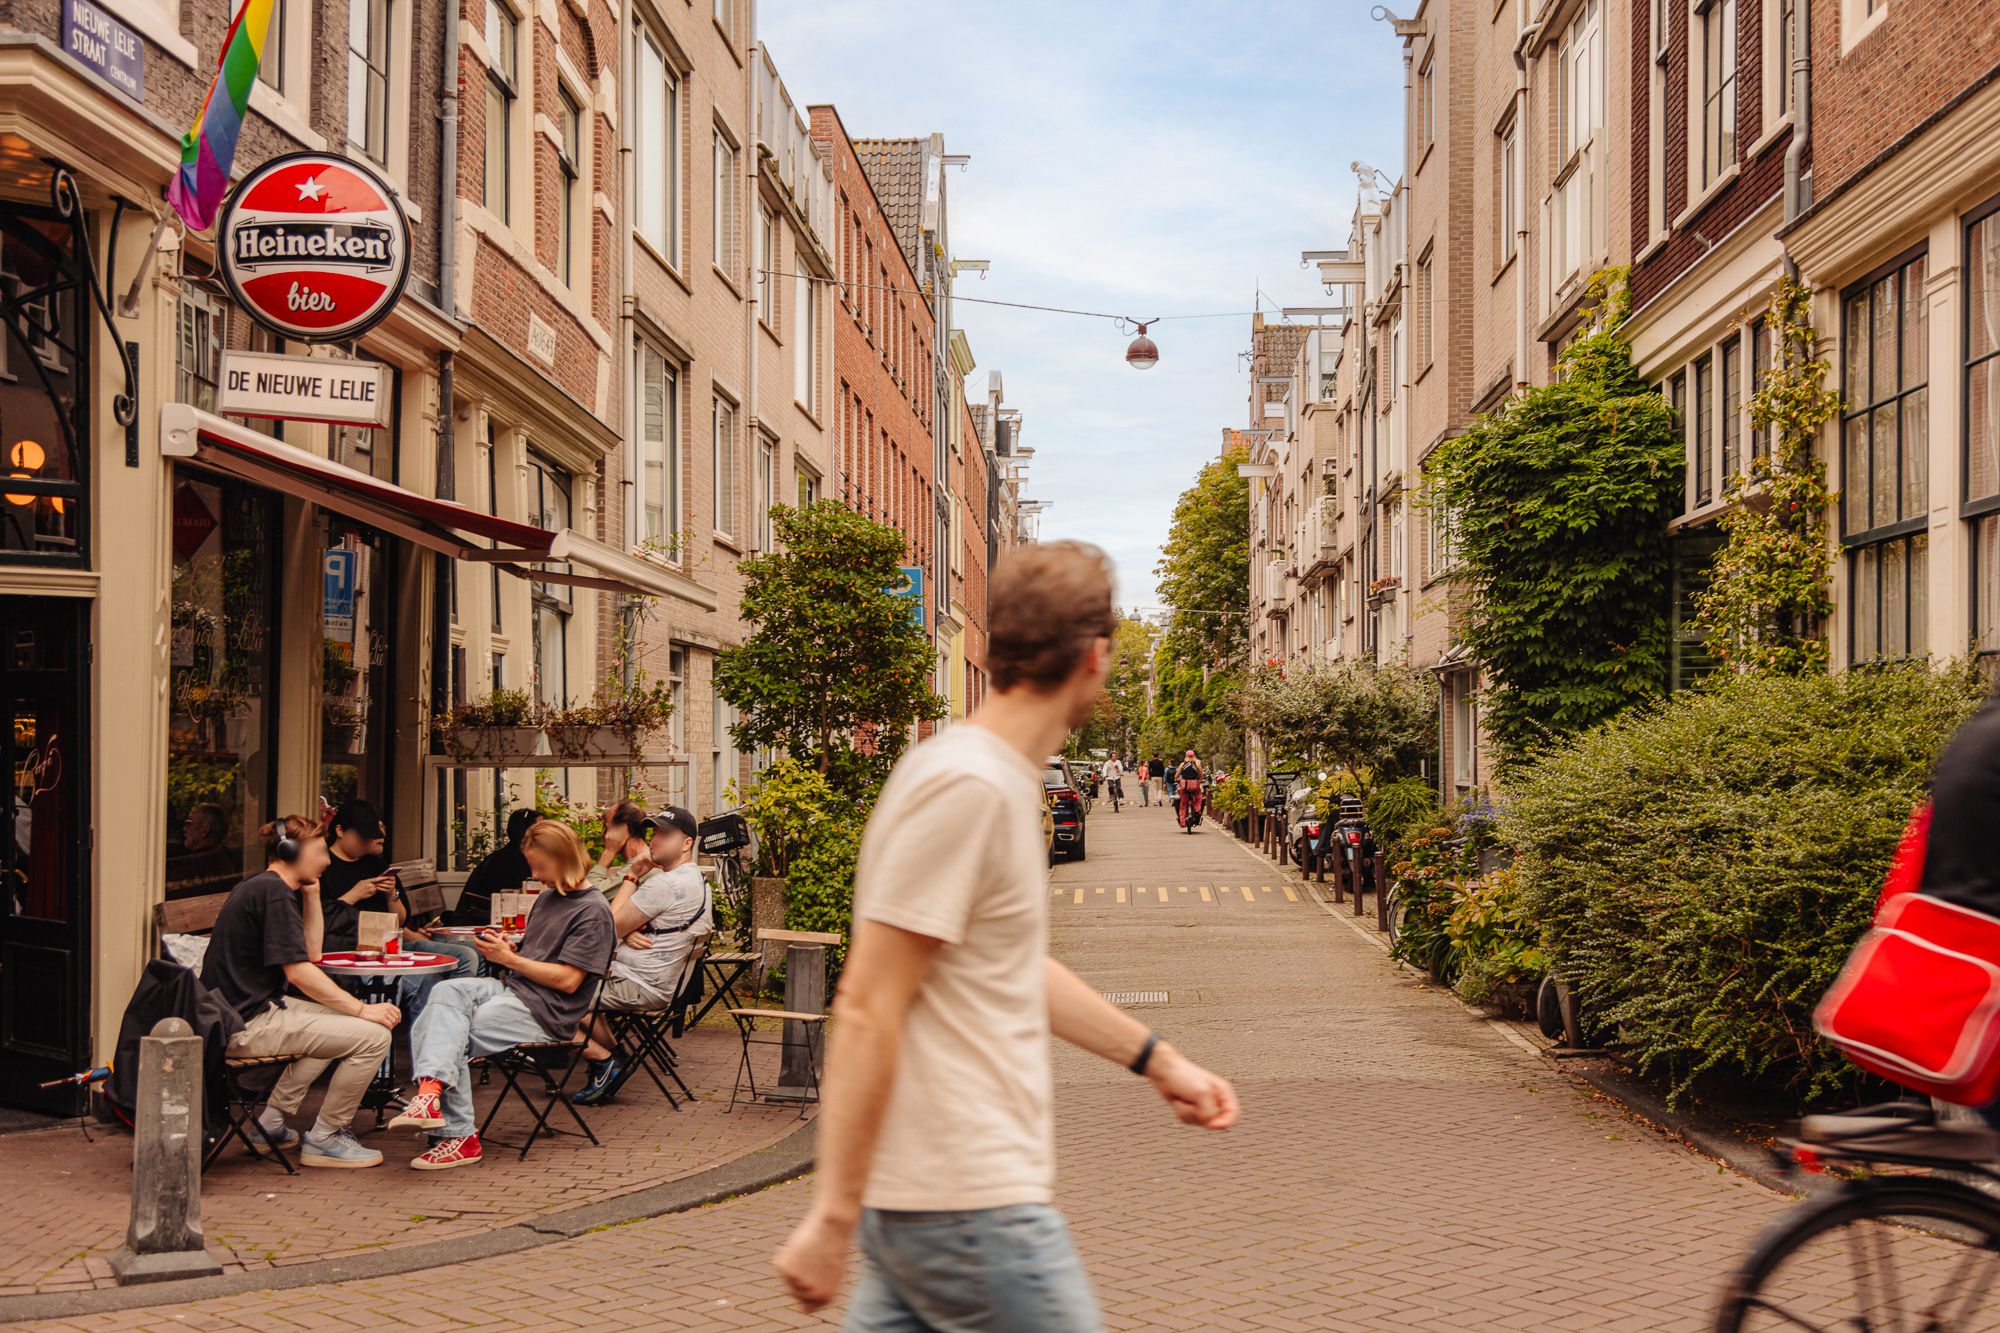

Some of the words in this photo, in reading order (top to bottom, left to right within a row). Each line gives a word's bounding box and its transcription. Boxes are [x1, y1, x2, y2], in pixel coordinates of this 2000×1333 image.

[73, 1, 110, 43] NIEUWE
[114, 27, 136, 60] LELIE
[72, 27, 106, 67] STRAAT
[110, 65, 136, 91] CENTRUM
[239, 227, 387, 260] Heineken
[287, 281, 336, 312] bier
[228, 370, 250, 391] DE
[256, 373, 322, 397] NIEUWE
[329, 379, 375, 401] LELIE
